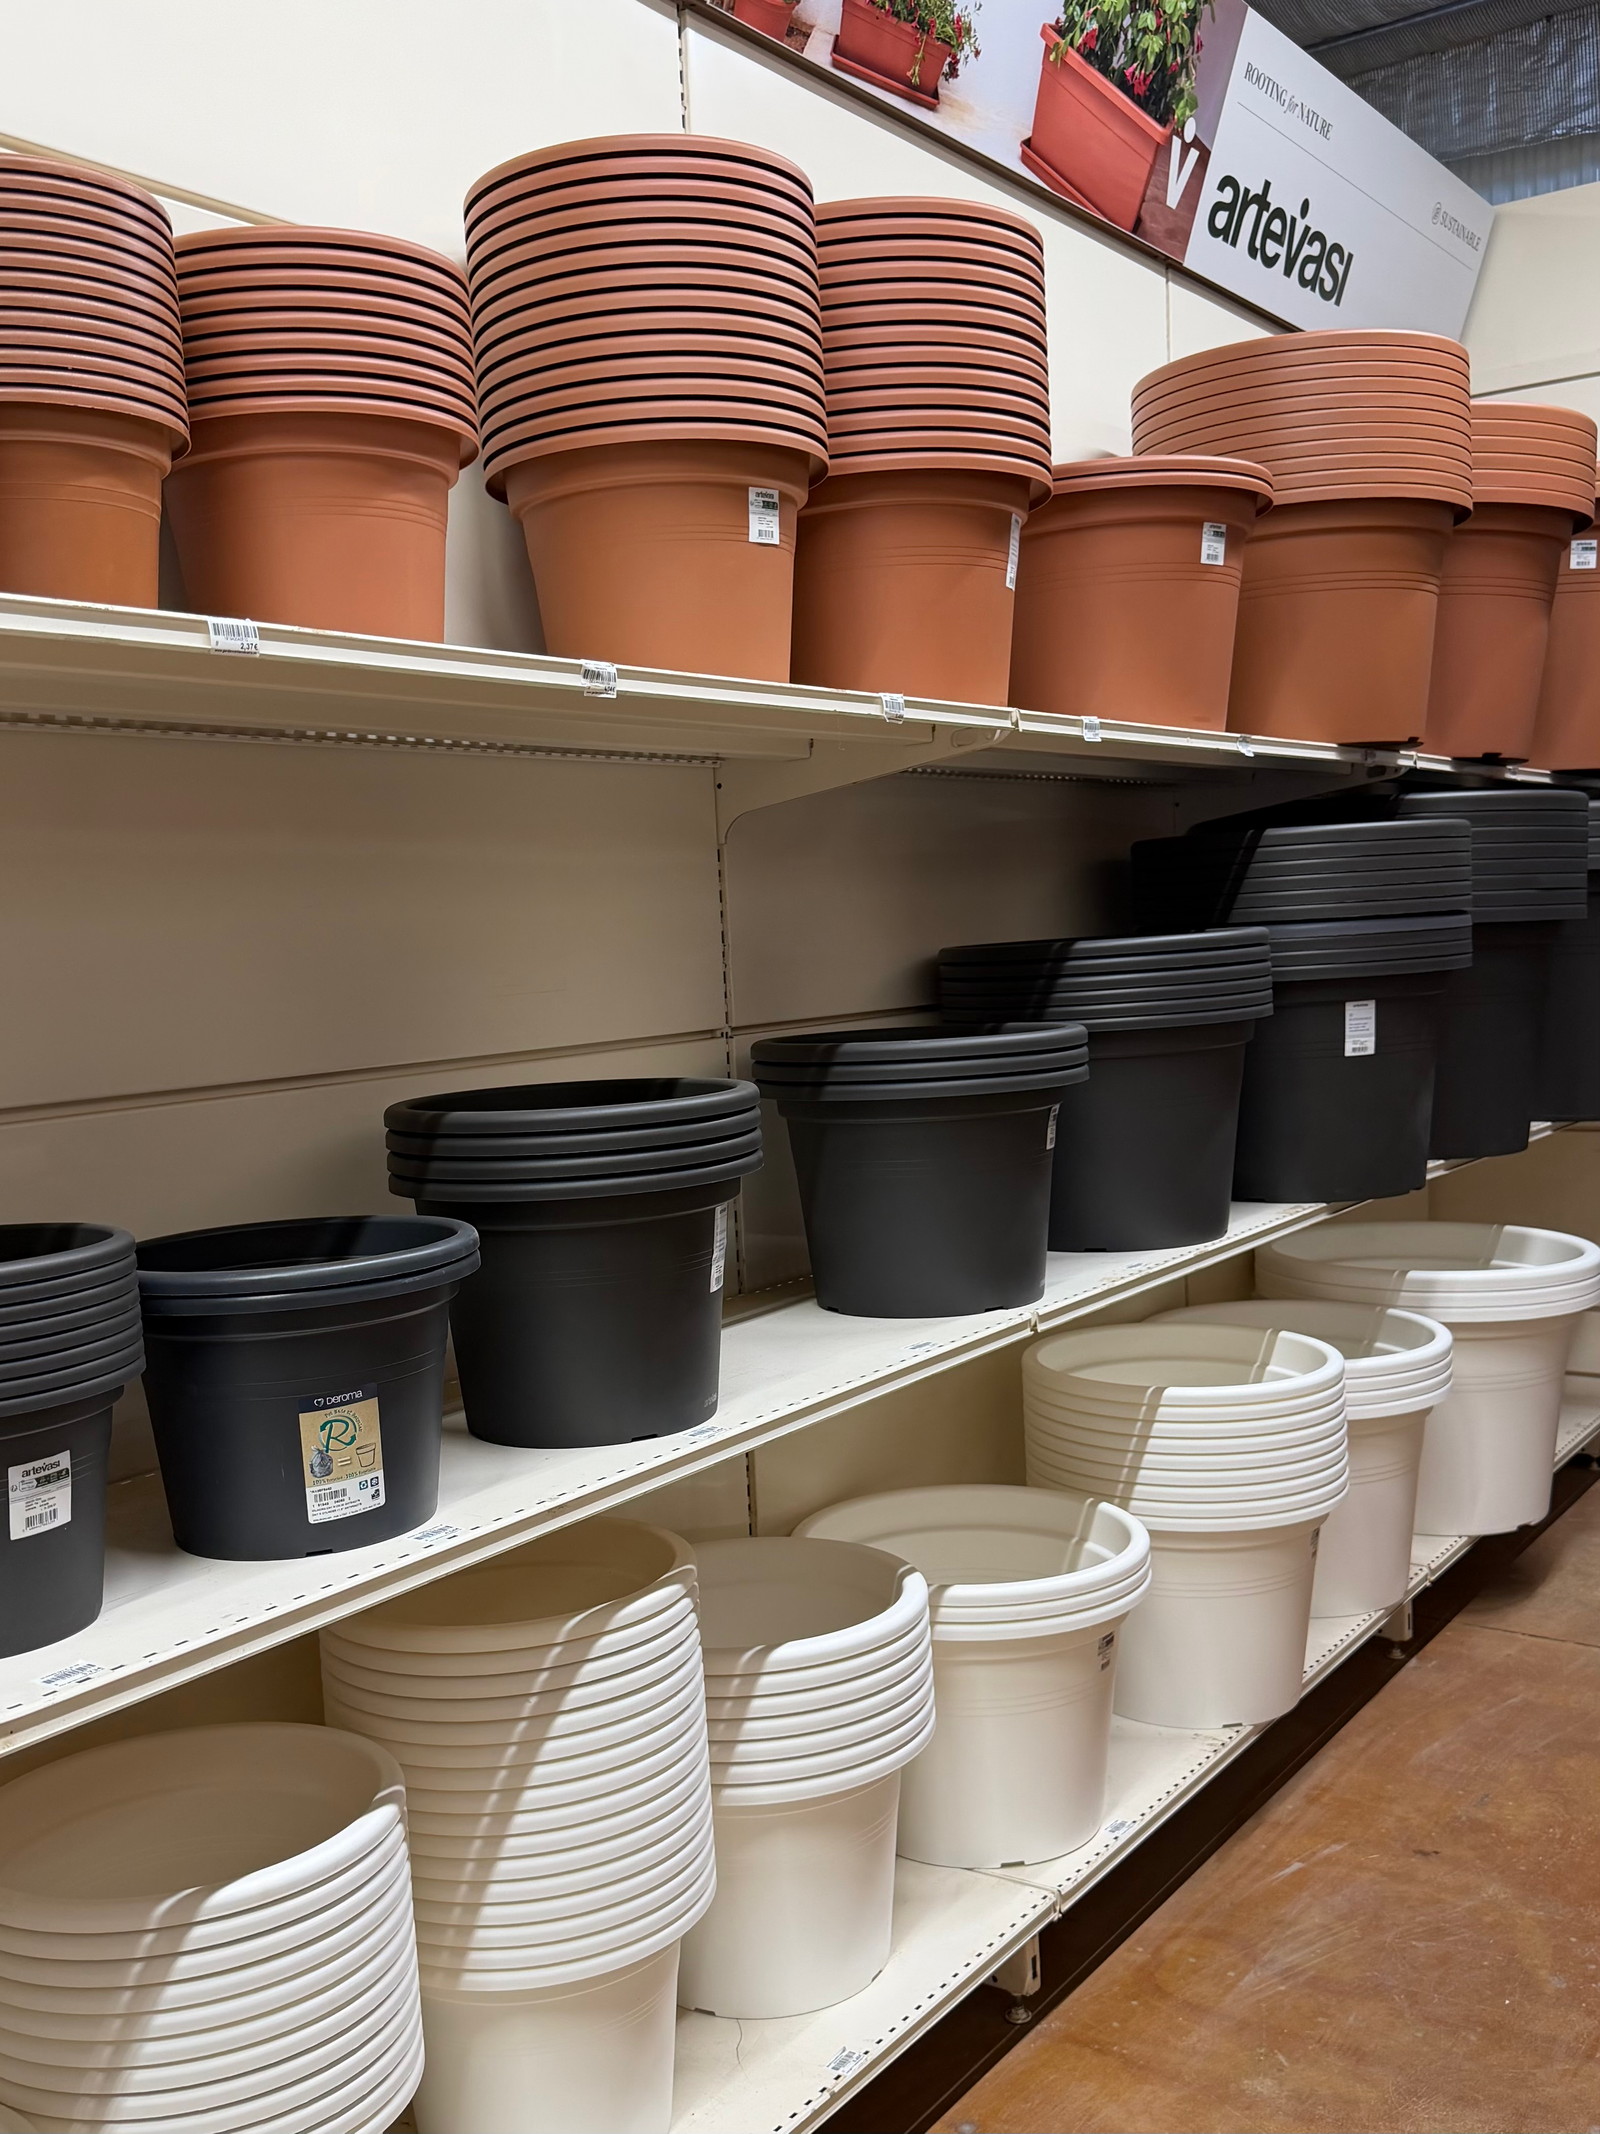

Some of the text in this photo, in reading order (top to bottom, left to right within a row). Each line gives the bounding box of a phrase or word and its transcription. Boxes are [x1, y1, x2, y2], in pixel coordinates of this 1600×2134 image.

[1243, 61, 1334, 141] ROOTING for NATURE
[1207, 174, 1354, 308] artevasi
[1440, 210, 1482, 252] SUSTAINABLE
[21, 1460, 61, 1478] artevasi
